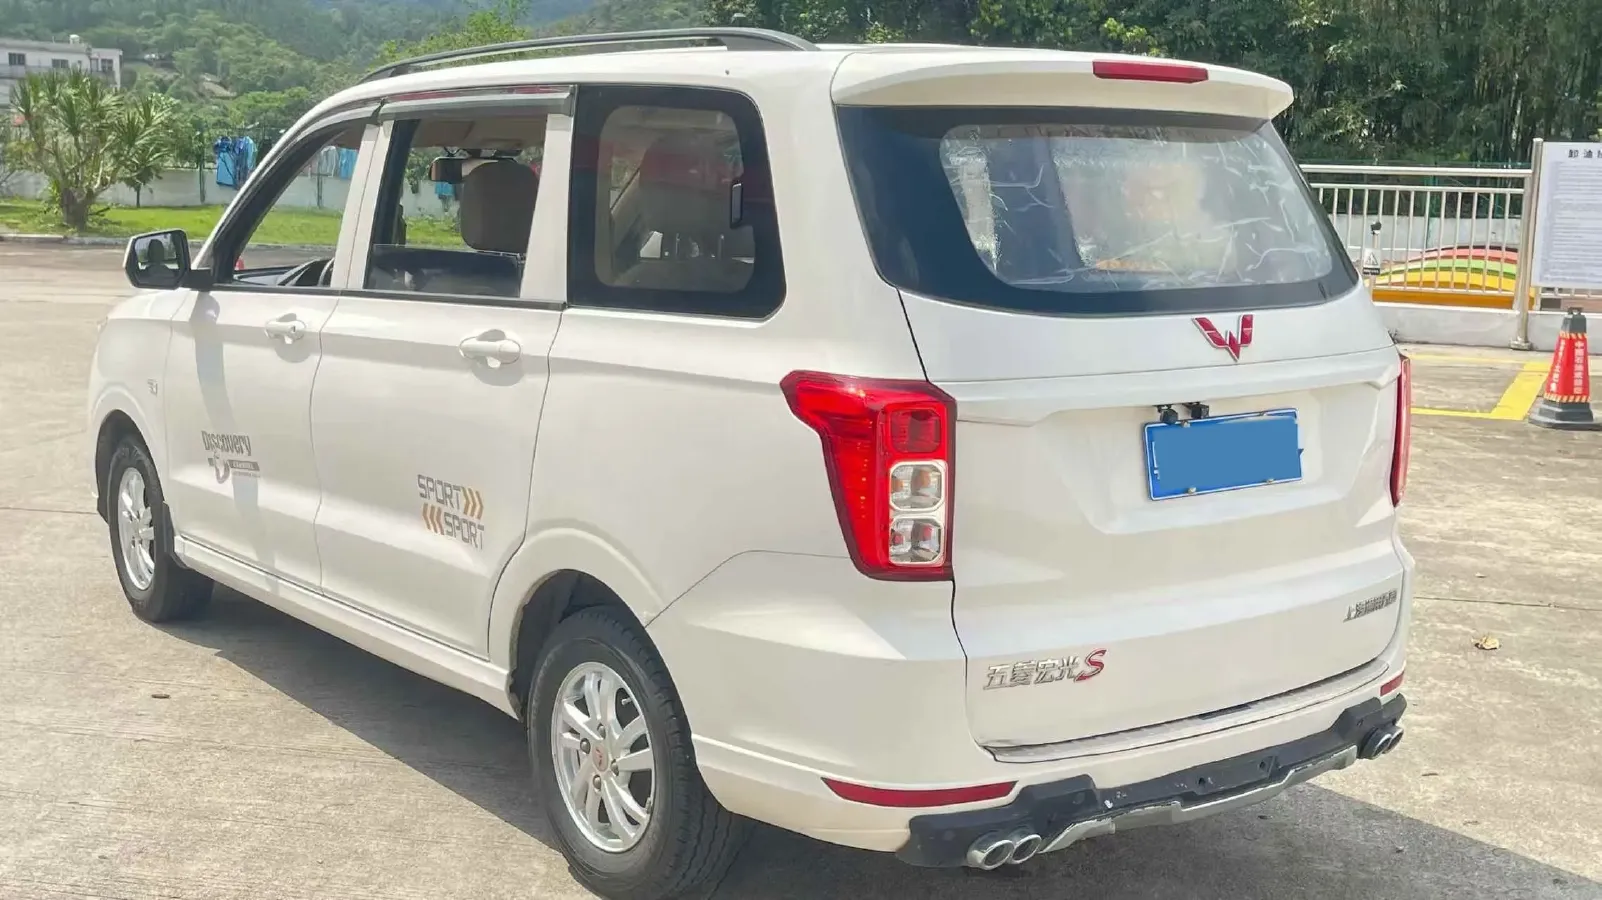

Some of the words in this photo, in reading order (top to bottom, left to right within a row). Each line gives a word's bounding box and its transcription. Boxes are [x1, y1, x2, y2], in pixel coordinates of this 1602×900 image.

[201, 430, 252, 457] Discovery
[417, 474, 461, 510] SPORT
[444, 511, 485, 550] SPORT
